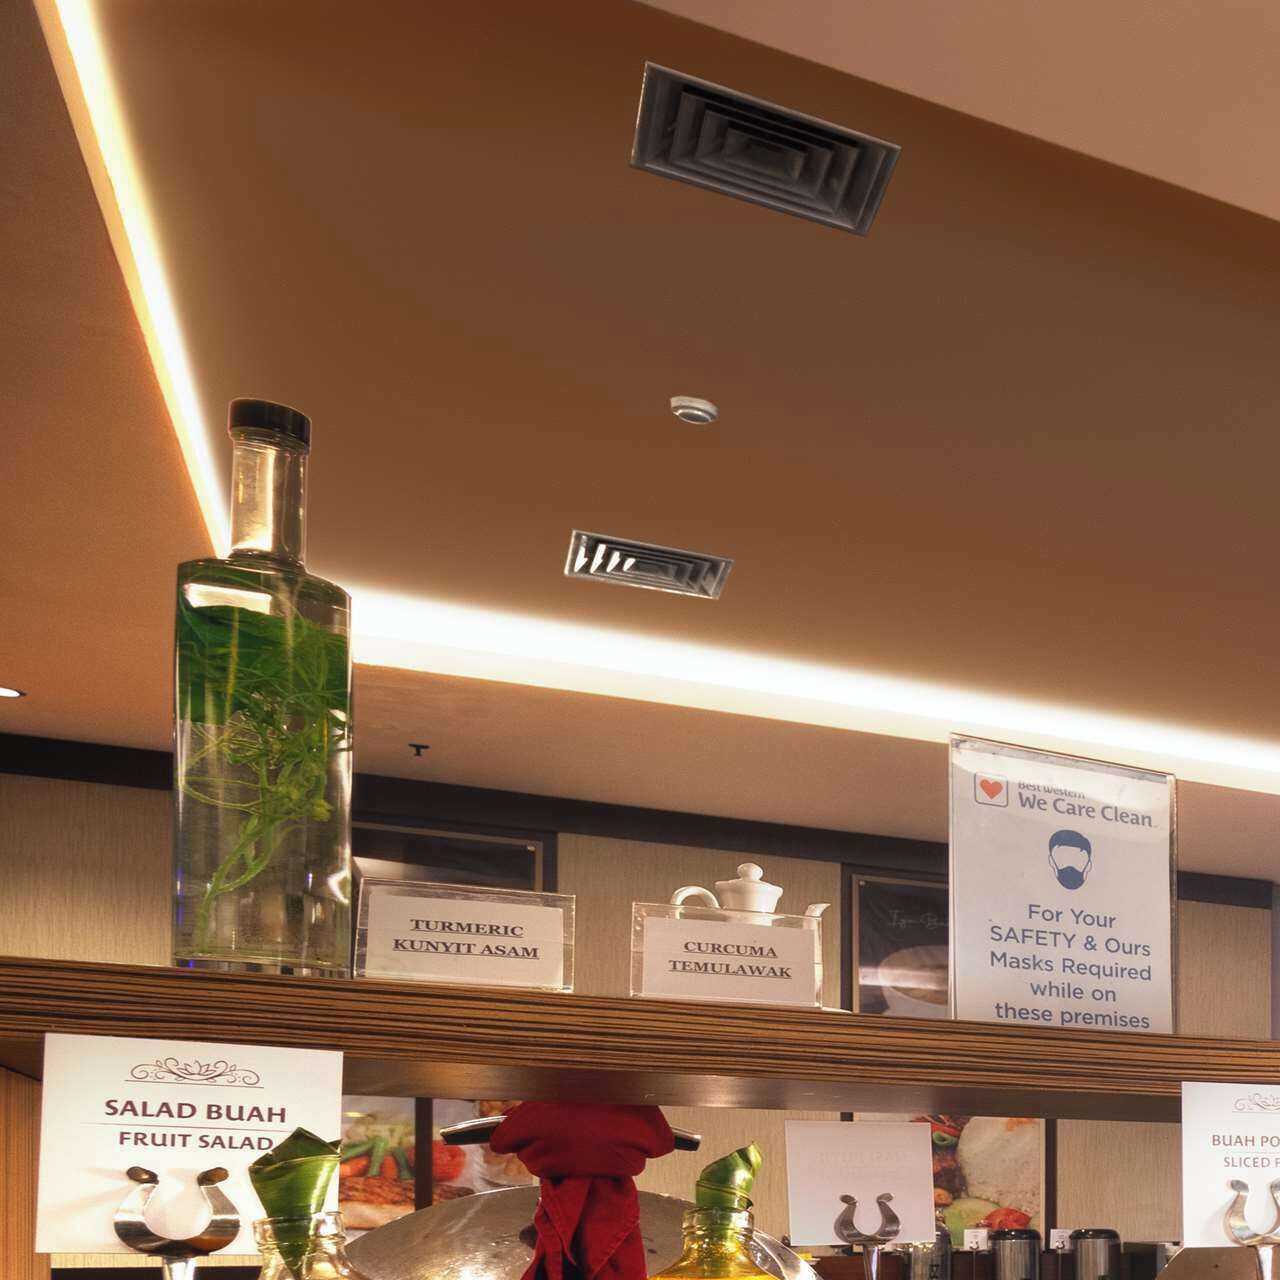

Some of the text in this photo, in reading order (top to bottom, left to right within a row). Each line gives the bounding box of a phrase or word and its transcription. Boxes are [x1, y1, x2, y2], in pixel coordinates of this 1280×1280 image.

[1018, 791, 1153, 828] We Care Clean
[1028, 904, 1116, 929] For Your
[410, 919, 524, 938] TURMERIC
[394, 939, 540, 959] KUNYIT ASAM
[684, 941, 778, 958] CURCUMA
[990, 926, 1151, 957] SAFETY & Ours
[669, 960, 792, 979] TEMULAWAK
[990, 951, 1151, 981] Masks Required
[1030, 981, 1116, 1002] while on
[995, 1002, 1150, 1028] these premises
[105, 1100, 286, 1123] SALAD BUAH
[119, 1131, 274, 1151] FRUIT SALAD
[1212, 1134, 1255, 1147] BUAH
[1223, 1156, 1270, 1168] SLICED
